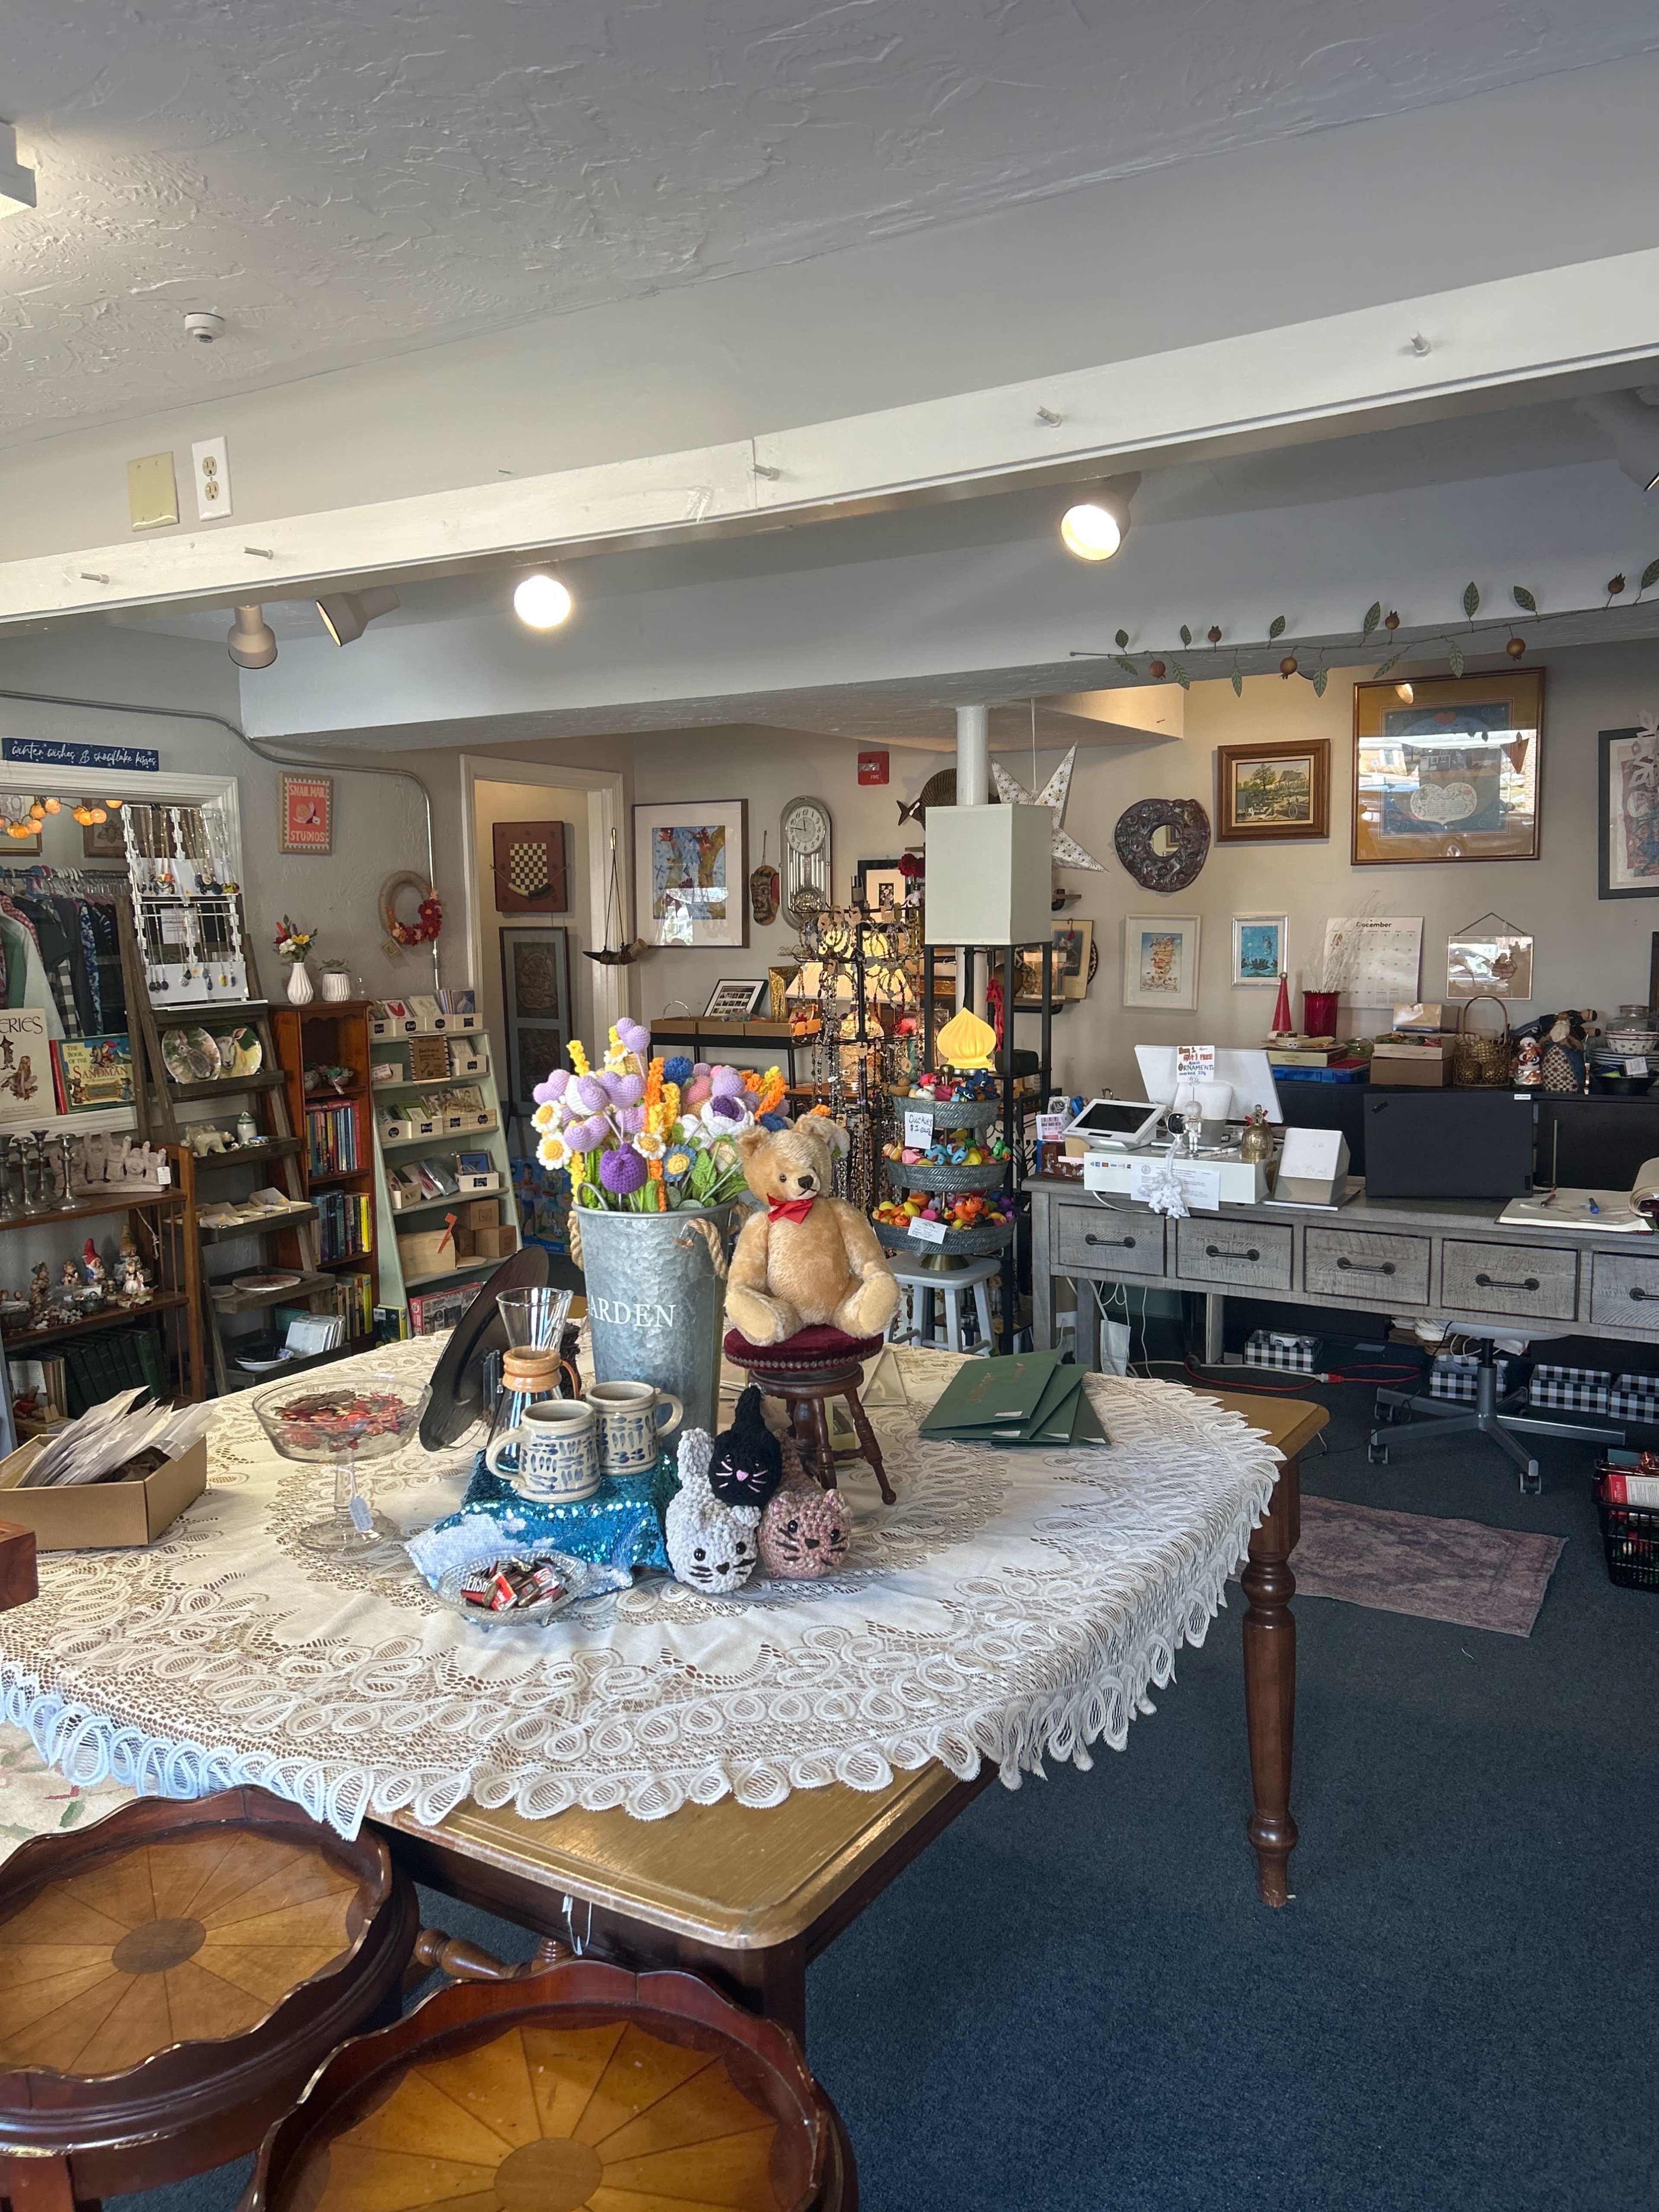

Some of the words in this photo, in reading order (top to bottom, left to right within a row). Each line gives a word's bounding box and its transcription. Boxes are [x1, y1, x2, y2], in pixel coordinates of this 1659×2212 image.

[12, 742, 43, 760] winter
[47, 744, 75, 760] wishes
[79, 750, 90, 764] &
[93, 750, 133, 766] snowflake
[135, 751, 157, 766] kisses
[290, 785, 309, 796] SNAIL
[311, 786, 326, 798] MAIL
[290, 830, 325, 842] STUDIOS
[589, 1294, 677, 1328] ARDEN
